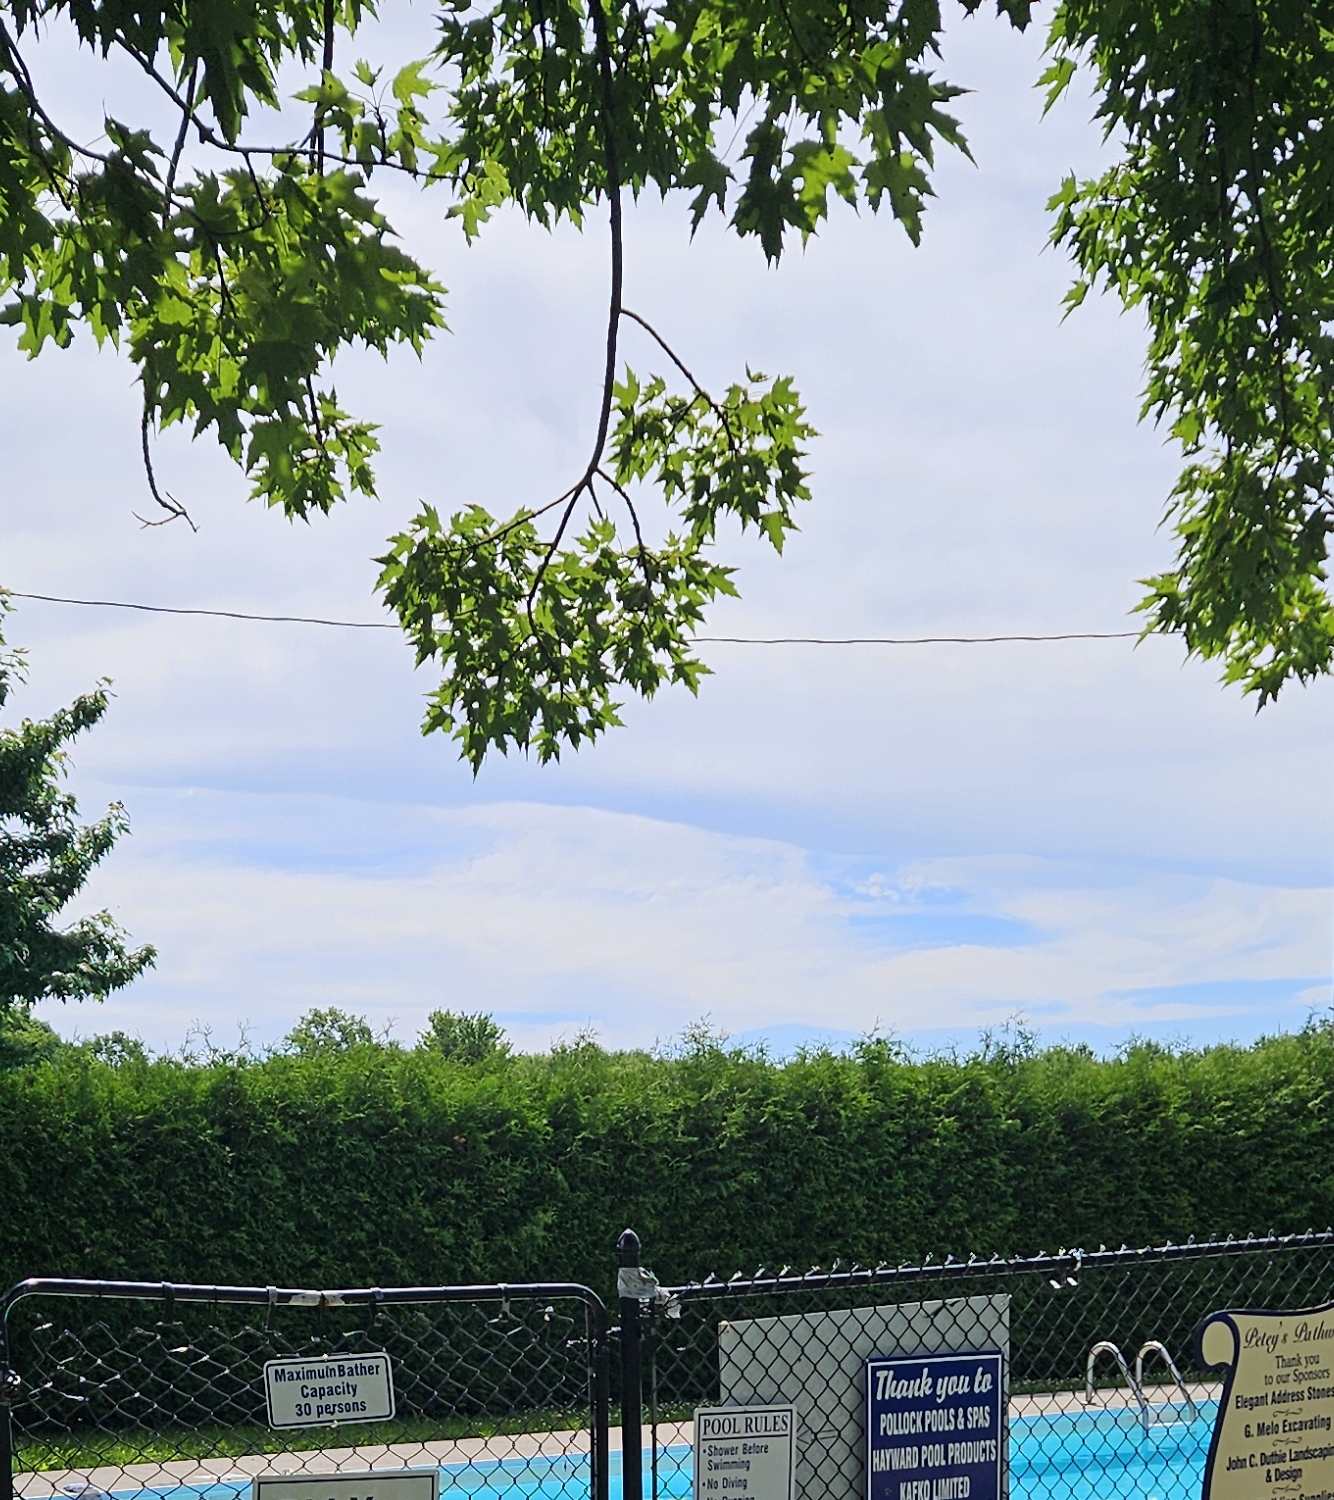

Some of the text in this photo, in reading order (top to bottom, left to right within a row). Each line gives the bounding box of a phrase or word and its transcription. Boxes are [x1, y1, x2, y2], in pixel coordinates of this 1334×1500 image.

[1243, 1322, 1287, 1353] Petey's
[1275, 1353, 1319, 1369] Thank you
[275, 1363, 380, 1382] Maximum Bather
[1265, 1367, 1330, 1385] to our Sponsors
[301, 1382, 357, 1400] Capacity
[876, 1367, 992, 1403] Thank you to
[295, 1400, 366, 1417] 30 persons
[1236, 1394, 1268, 1410] Elegant
[1271, 1390, 1304, 1405] Address
[703, 1415, 788, 1435] POOL RULES
[880, 1406, 990, 1436] POLLOCK POOLS & SPAS
[1244, 1415, 1331, 1438] G. Melo Excavating
[707, 1443, 768, 1456] Shower Before
[873, 1439, 996, 1472] HAYWARD POOL PRODUCTS
[708, 1458, 750, 1471] Swimming
[1226, 1454, 1247, 1471] John
[1249, 1453, 1258, 1467] C.
[1260, 1448, 1287, 1466] Duthie
[707, 1477, 747, 1490] No Diving
[1266, 1466, 1302, 1482] & Design
[933, 1476, 970, 1500] LIMITED
